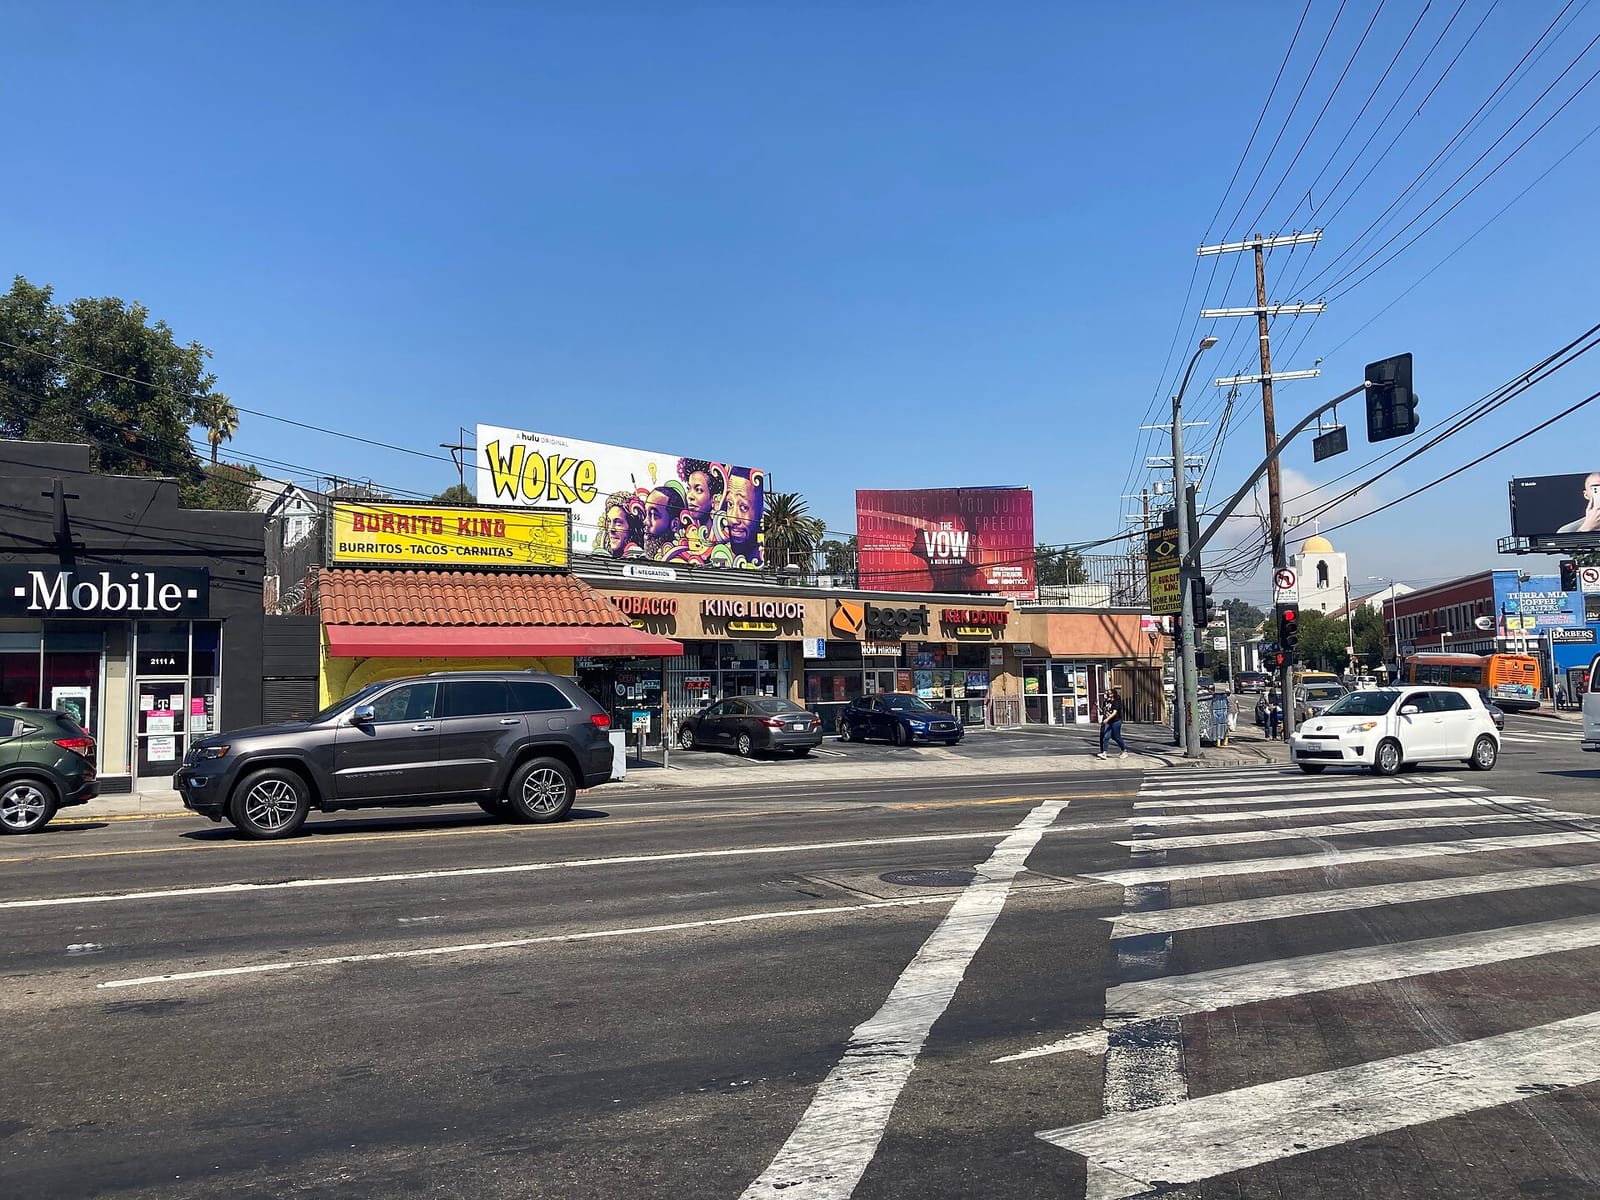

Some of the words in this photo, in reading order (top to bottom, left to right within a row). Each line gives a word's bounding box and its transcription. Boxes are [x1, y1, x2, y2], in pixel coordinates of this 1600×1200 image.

[522, 432, 540, 442] hulu
[352, 512, 444, 534] BURRITO
[457, 516, 506, 538] KING
[940, 522, 953, 531] THE
[339, 542, 403, 554] BURRITOS
[924, 531, 969, 557] VOW
[1158, 573, 1179, 584] BURRIT
[26, 570, 182, 611] Mobile
[612, 596, 678, 616] TOBACCO
[704, 599, 746, 616] KING
[750, 601, 806, 619] LIQUOR
[864, 602, 930, 628] boost
[943, 609, 968, 624] K&K
[970, 610, 1009, 625] DONUT
[1552, 630, 1593, 639] BARBERS
[862, 646, 876, 654] NOW
